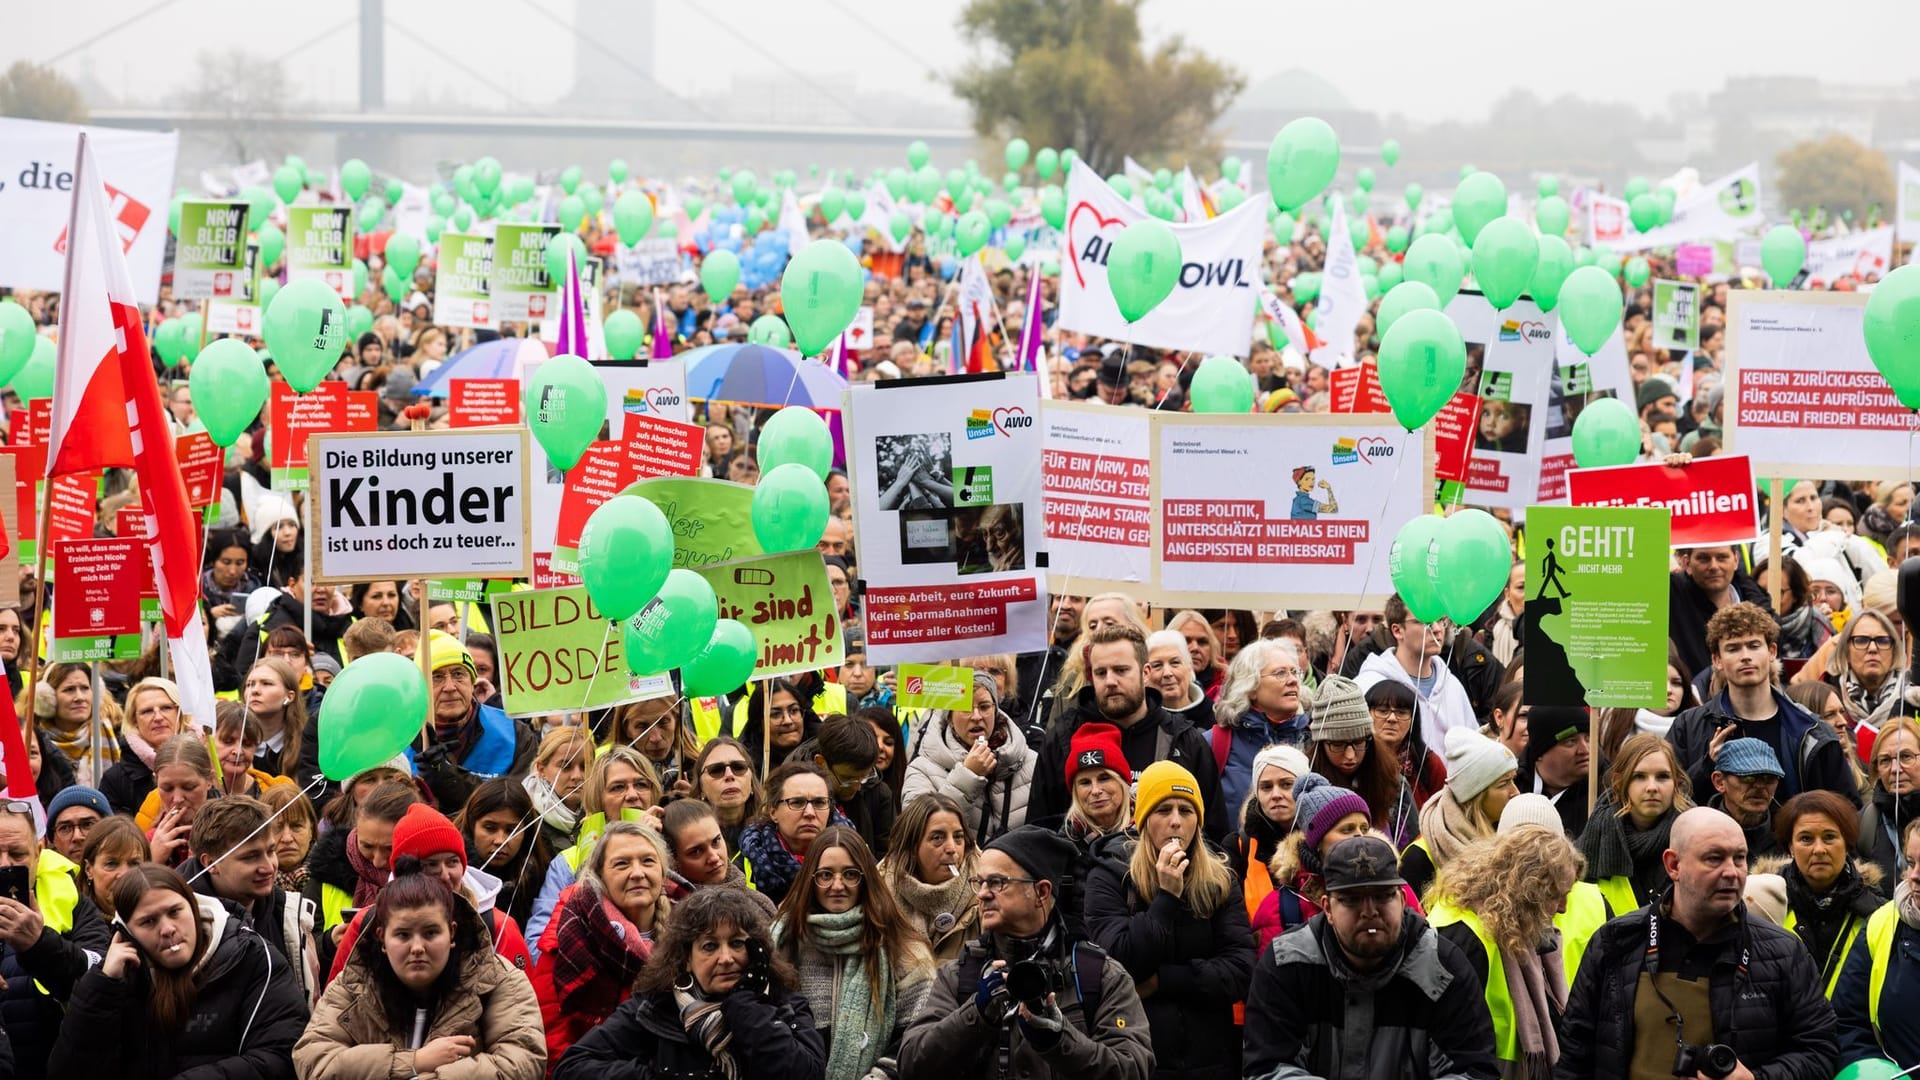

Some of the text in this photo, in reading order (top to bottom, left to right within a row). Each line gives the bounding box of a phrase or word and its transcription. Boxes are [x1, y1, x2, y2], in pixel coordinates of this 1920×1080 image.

[18, 162, 73, 191] die
[206, 209, 239, 226] NRW
[312, 213, 343, 229] NRW
[197, 227, 237, 244] BLEIB
[305, 230, 342, 246] BLEIB
[520, 231, 552, 249] NRW
[183, 245, 236, 264] SOZIAL!
[463, 241, 493, 258] NRW
[498, 268, 548, 286] SOZIAL!
[1178, 259, 1250, 288] OWL
[1528, 329, 1551, 339] AWO
[1743, 372, 1789, 385] KEINEN
[655, 396, 680, 406] AWO
[1743, 388, 1768, 404] FÜR
[1771, 391, 1820, 406] SOZIALE
[1004, 416, 1033, 429] AWO
[1741, 410, 1799, 424] SOZIALEN
[1803, 411, 1856, 425] FRIEDEN
[636, 431, 650, 440] aufs
[639, 420, 688, 437] Wer Menschen
[967, 426, 994, 438] Unsere
[326, 449, 514, 470] Die Bildung unserer
[655, 445, 678, 457] fördert
[679, 451, 692, 460] den
[1367, 446, 1394, 456] AWO
[1042, 452, 1150, 478] FÜR EIN NRW, DA
[1542, 459, 1568, 470] rbeit,
[599, 469, 617, 480] zeige
[972, 474, 990, 482] NRW
[1041, 473, 1150, 496] SOLIDARISCH STEH
[329, 472, 514, 528] Kinder
[1581, 490, 1748, 517] milien
[1043, 501, 1110, 520] EMEINSAM
[1167, 503, 1260, 520] LIEBE POLITIK,
[1058, 523, 1150, 543] MENSCHEN GEH
[1167, 521, 1366, 538] UNTERSCHÄTZT NIEMALS EINEN
[76, 545, 91, 553] will,
[92, 544, 107, 552] dass
[108, 543, 131, 551] meine
[328, 533, 516, 553] ist uns doch zu teuer...
[1166, 542, 1346, 558] ANGEPISSTEN BETRIEBSRAT!
[1561, 526, 1635, 558] GEHT!
[68, 553, 127, 563] Erzieherin Nicole
[73, 562, 122, 574] genug Zeit für
[1601, 564, 1623, 574] MEHR
[80, 573, 114, 582] mich hat!
[466, 581, 484, 591] NRW
[432, 588, 453, 598] BLEIB
[868, 585, 1020, 604] Unsere Arbeit, eure Zukunft
[717, 584, 813, 624] ir sind
[870, 606, 998, 622] Keine Sparmaßnahmen
[870, 622, 995, 639] auf unser aller Kosten!
[94, 639, 112, 648] NRW
[755, 613, 835, 668] imit!
[62, 650, 83, 660] BLEIB
[504, 640, 620, 695] KOSDE
